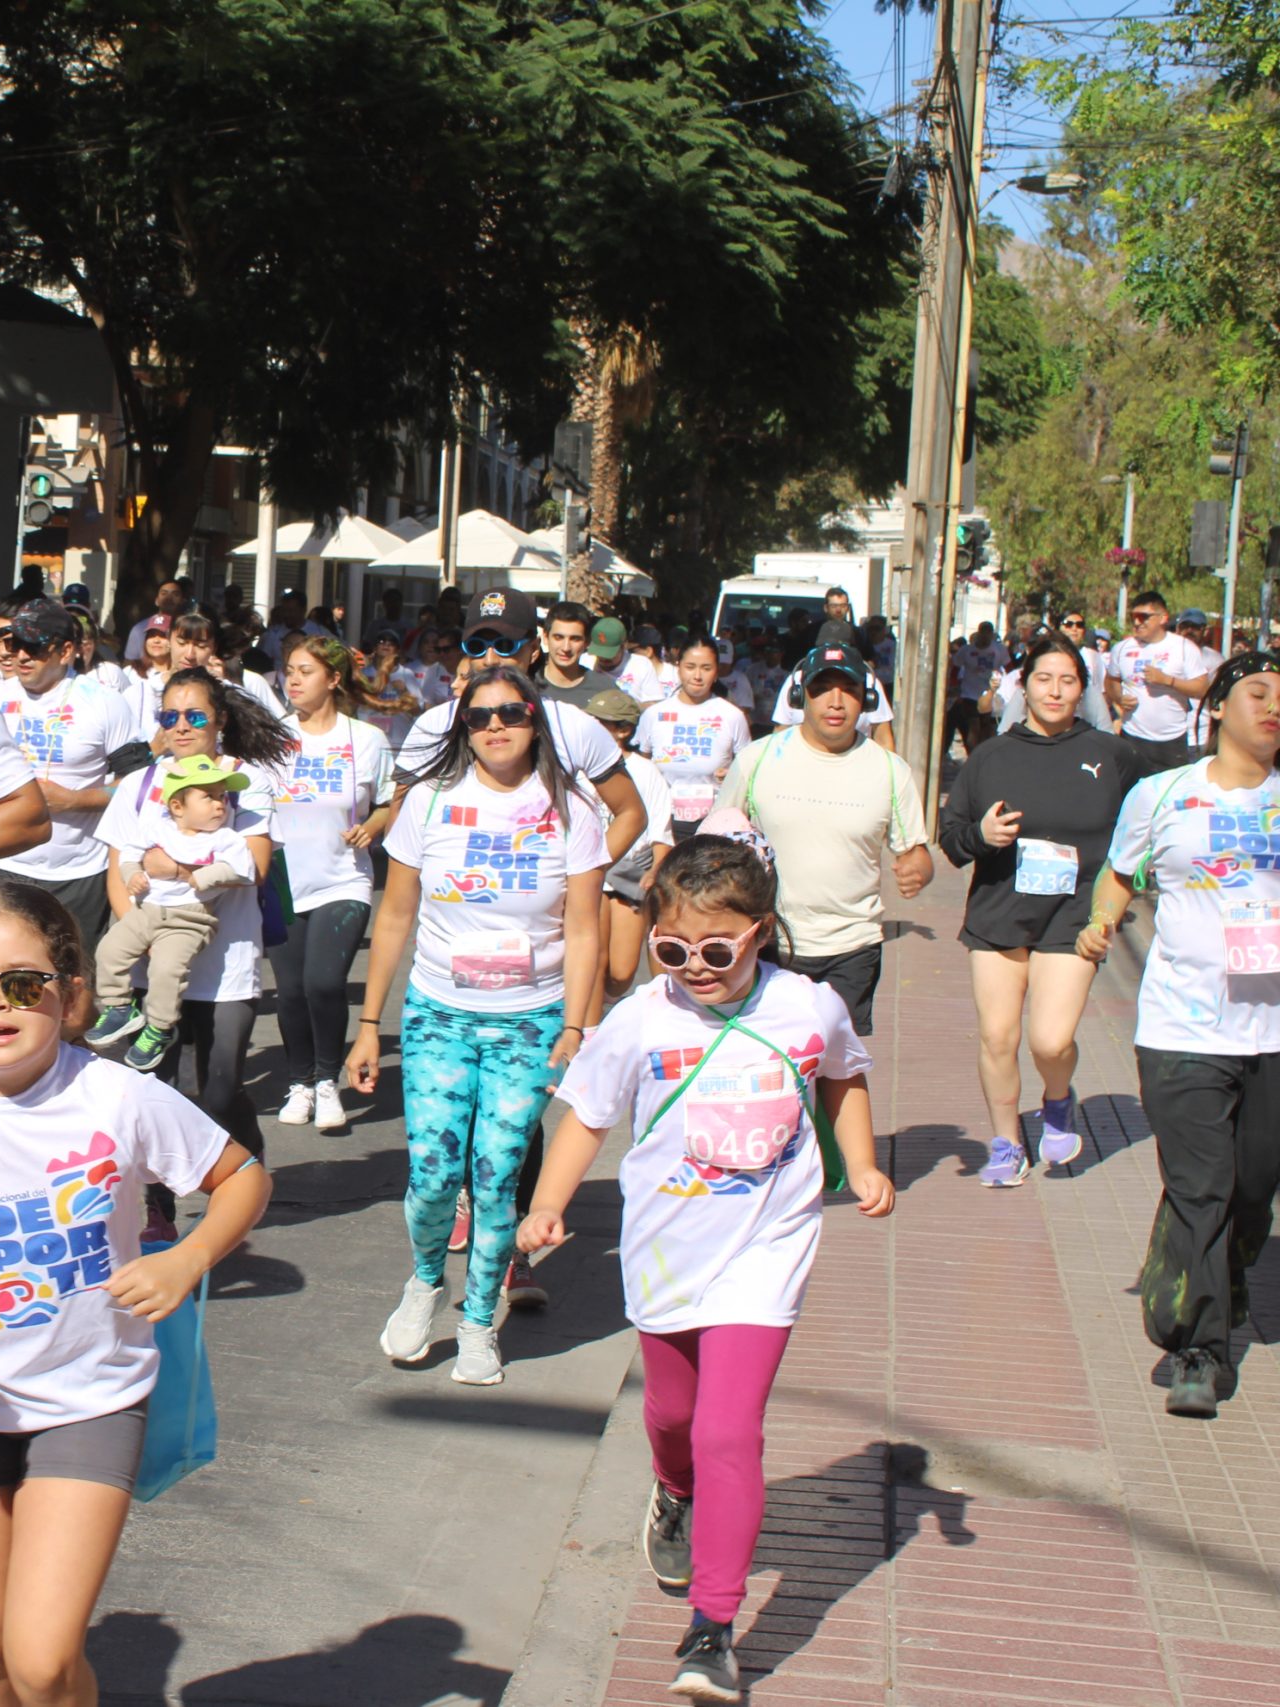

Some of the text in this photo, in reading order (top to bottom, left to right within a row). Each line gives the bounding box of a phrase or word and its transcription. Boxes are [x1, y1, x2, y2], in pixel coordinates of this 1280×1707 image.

[17, 719, 44, 733] DE
[674, 726, 697, 736] DE
[15, 732, 64, 748] POR
[672, 736, 712, 747] POR
[36, 748, 64, 763] TE
[690, 747, 711, 756] TE
[295, 757, 325, 768] DE
[293, 768, 343, 780] POR
[316, 781, 343, 793] TE
[1209, 814, 1261, 833] DE
[467, 832, 511, 851] DE
[464, 850, 540, 870] POR
[499, 871, 538, 890] TE
[1019, 871, 1073, 892] 3236
[32, 1187, 47, 1199] del
[47, 1248, 112, 1295] TE
